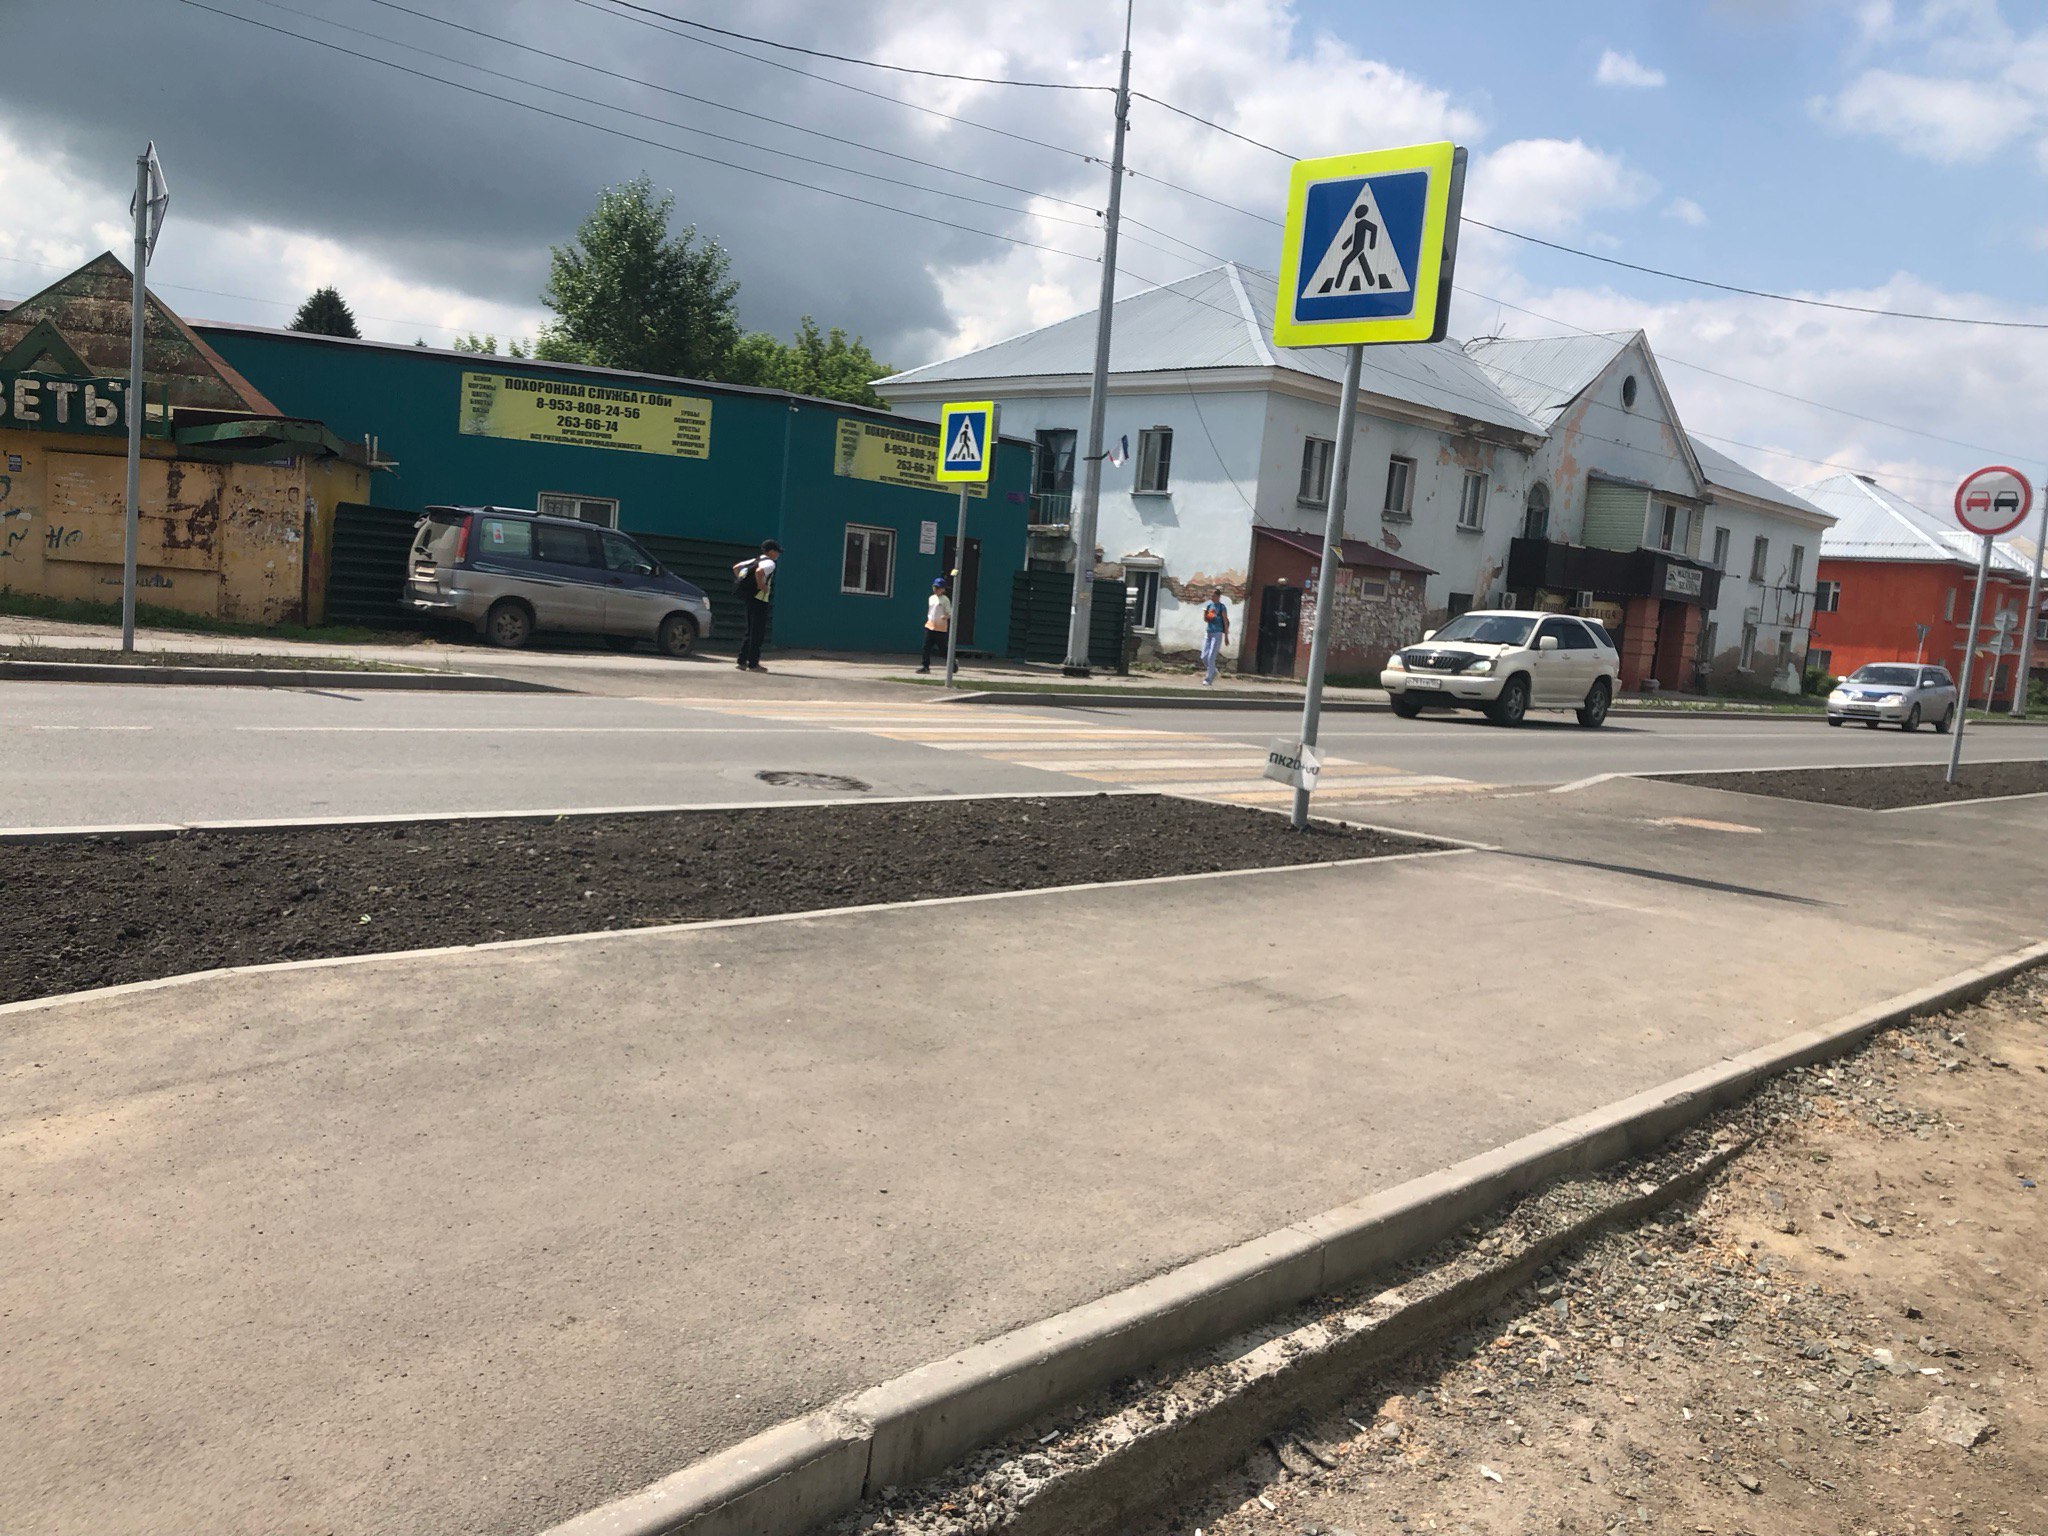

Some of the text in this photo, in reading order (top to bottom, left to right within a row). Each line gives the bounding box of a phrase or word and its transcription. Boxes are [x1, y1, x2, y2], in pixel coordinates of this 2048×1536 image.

[0, 378, 132, 428] ЕТЫ
[505, 378, 672, 408] ПОХОРОННАЯ СЛУЖБА г.Оби
[536, 397, 640, 419] 8-953-808-24-56
[556, 415, 619, 432] 263-66-74
[917, 434, 940, 448] СЛУЖ
[884, 443, 939, 461] 8-953-808-24-
